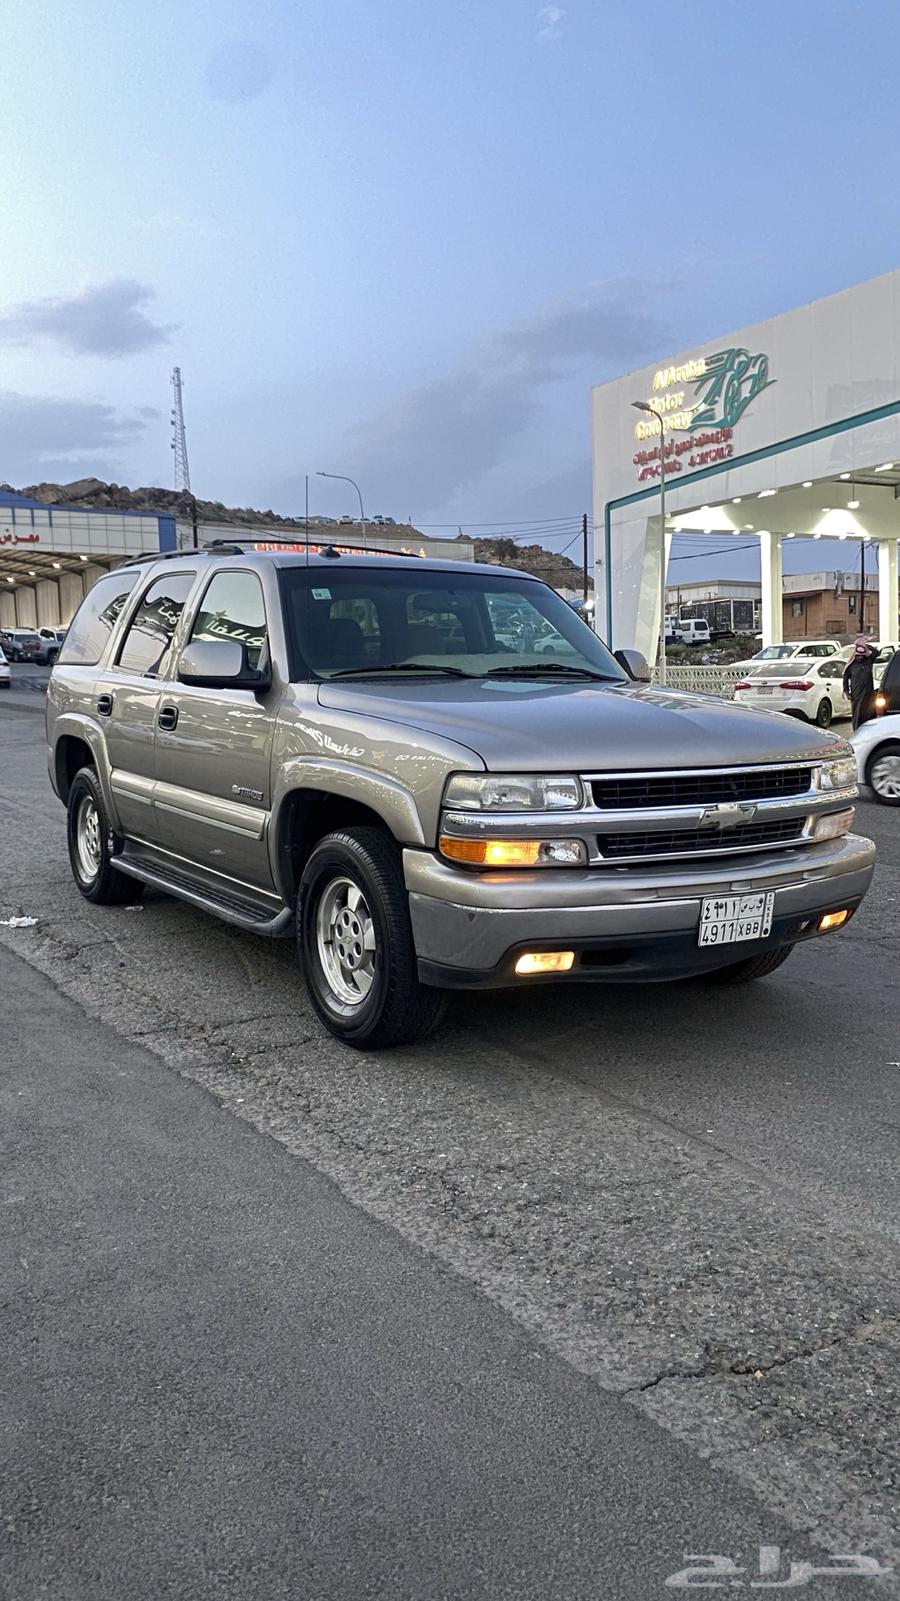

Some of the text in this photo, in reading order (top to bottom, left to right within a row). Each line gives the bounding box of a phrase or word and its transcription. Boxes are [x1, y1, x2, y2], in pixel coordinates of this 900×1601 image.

[634, 411, 694, 441] Company
[702, 922, 759, 943] 4911 XBB
